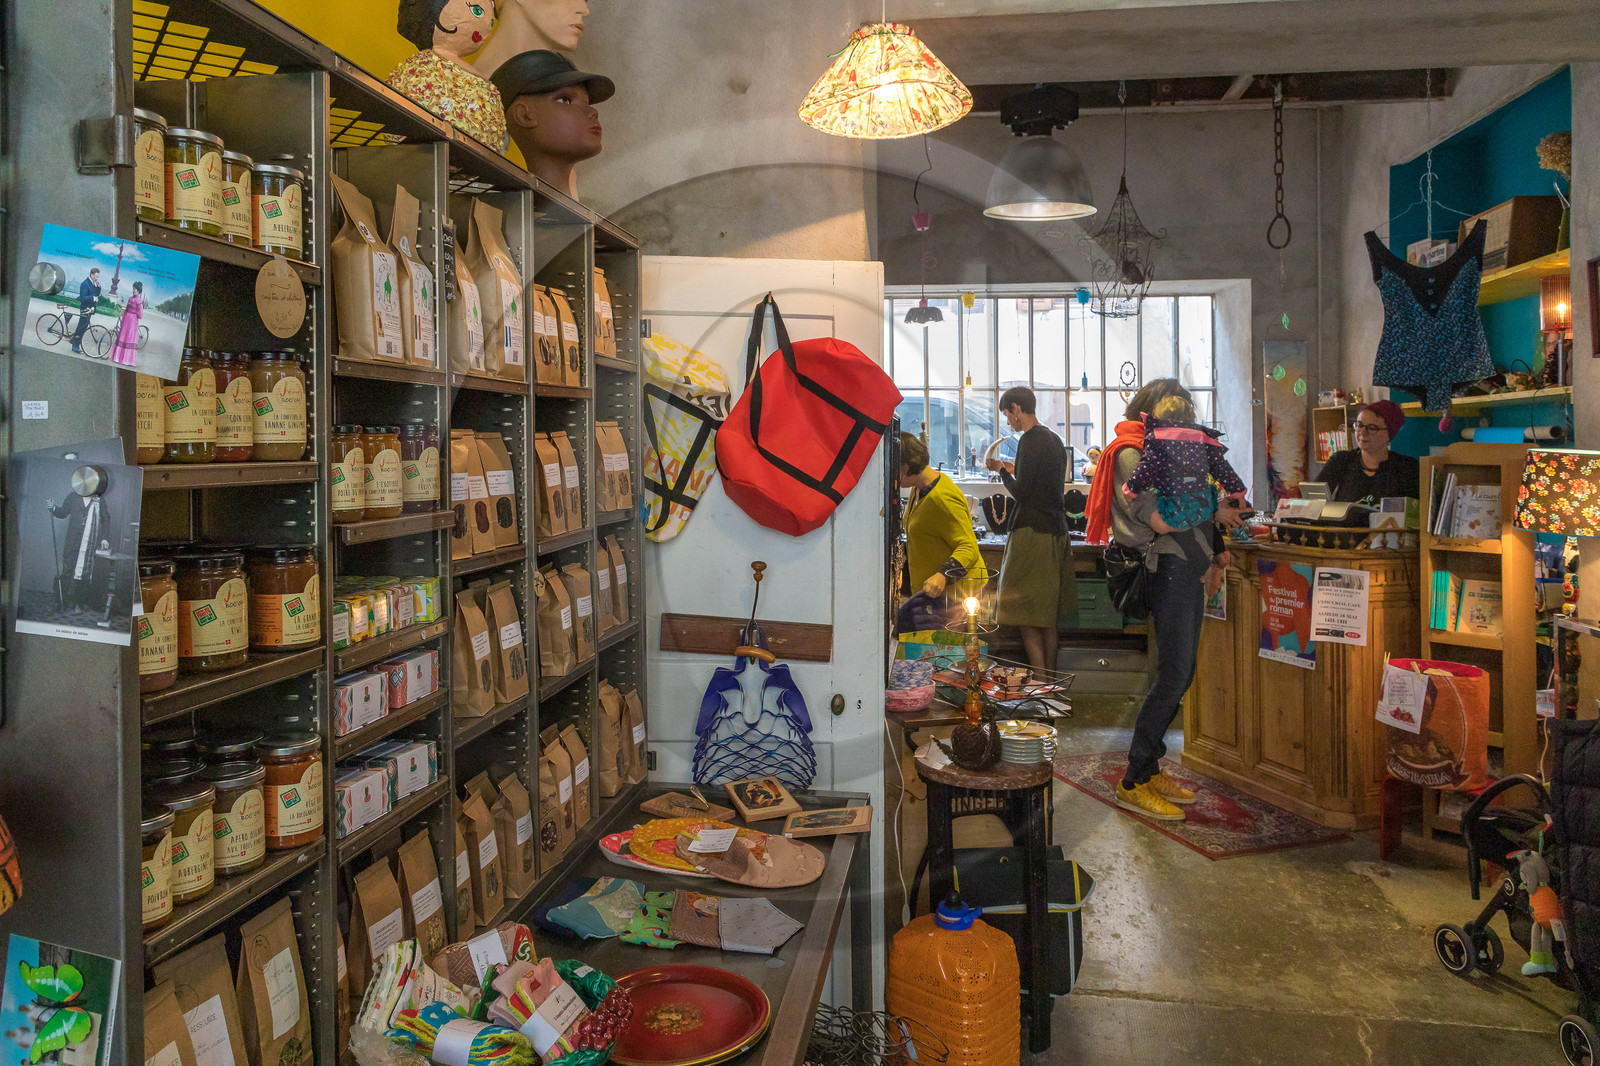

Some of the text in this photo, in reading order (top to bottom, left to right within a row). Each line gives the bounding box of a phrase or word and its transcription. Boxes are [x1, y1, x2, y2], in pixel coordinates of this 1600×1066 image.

[1268, 584, 1298, 599] Festival
[1275, 596, 1304, 609] premier
[1270, 604, 1294, 616] roman
